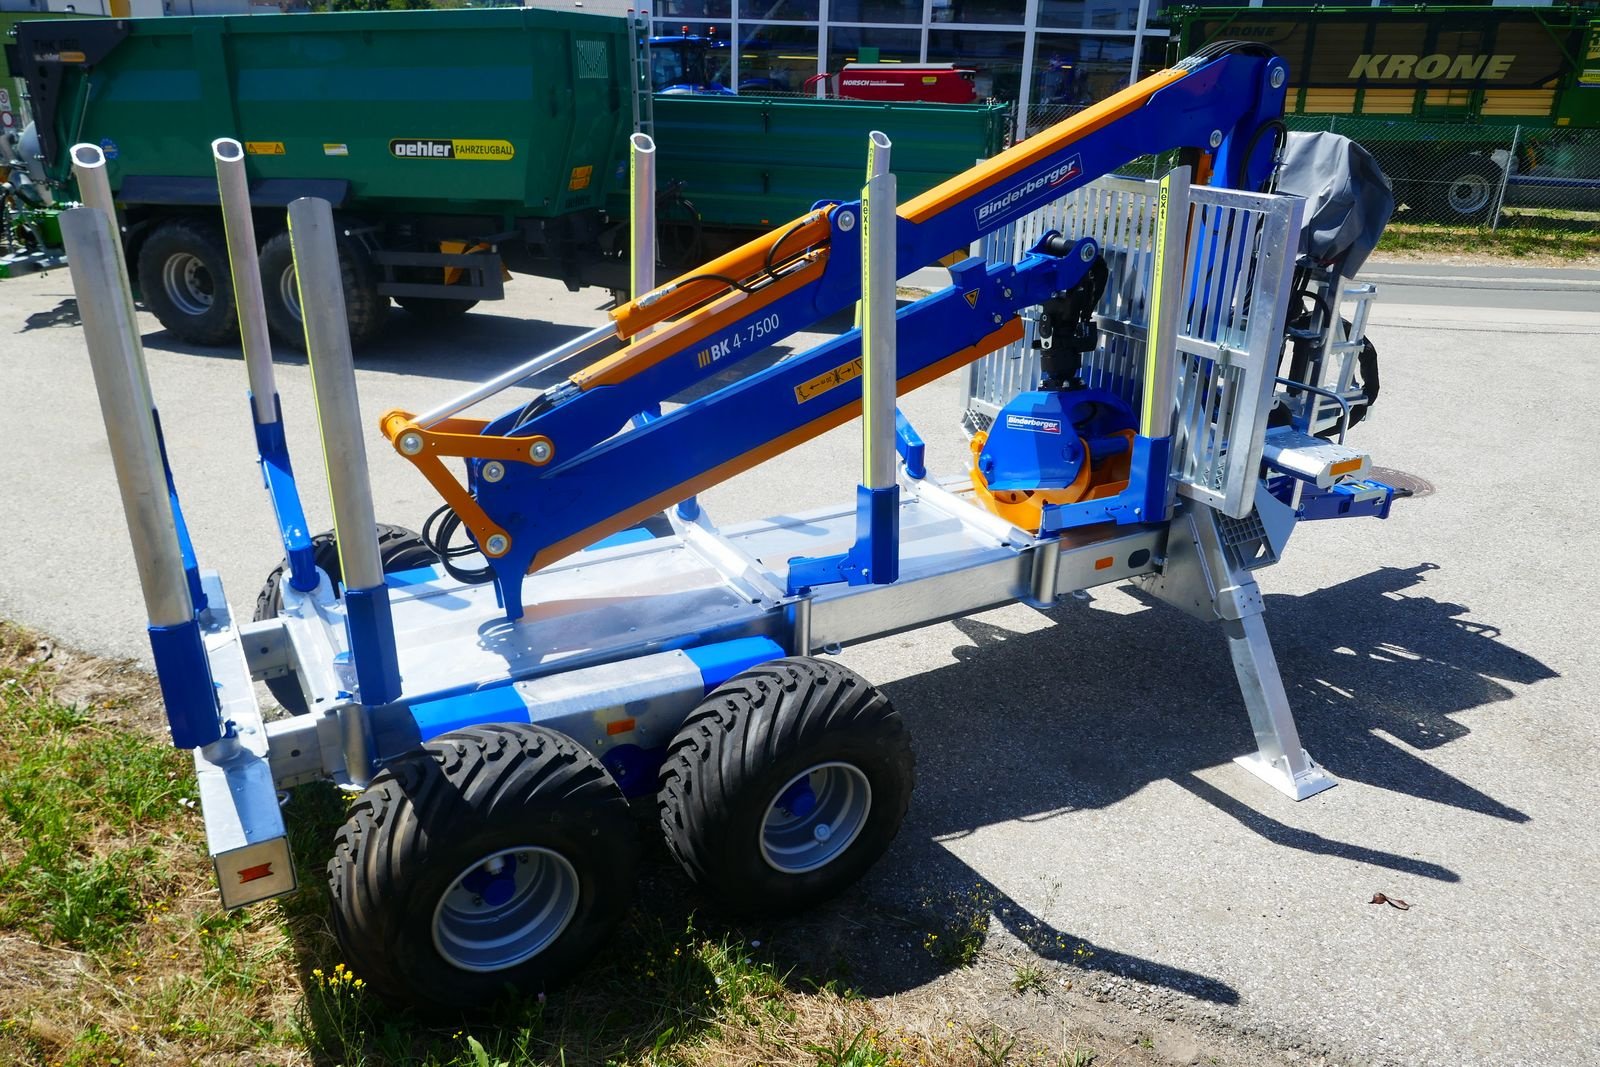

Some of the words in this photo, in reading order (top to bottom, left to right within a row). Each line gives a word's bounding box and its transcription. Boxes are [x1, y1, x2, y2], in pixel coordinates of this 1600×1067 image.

[1348, 54, 1516, 80] KRONE
[395, 141, 452, 157] oehler
[455, 145, 512, 155] FAHRZEUGBAU
[978, 160, 1076, 220] Binderberger
[1160, 186, 1168, 220] next
[710, 338, 731, 361] BK
[1008, 416, 1058, 429] Binderberger
